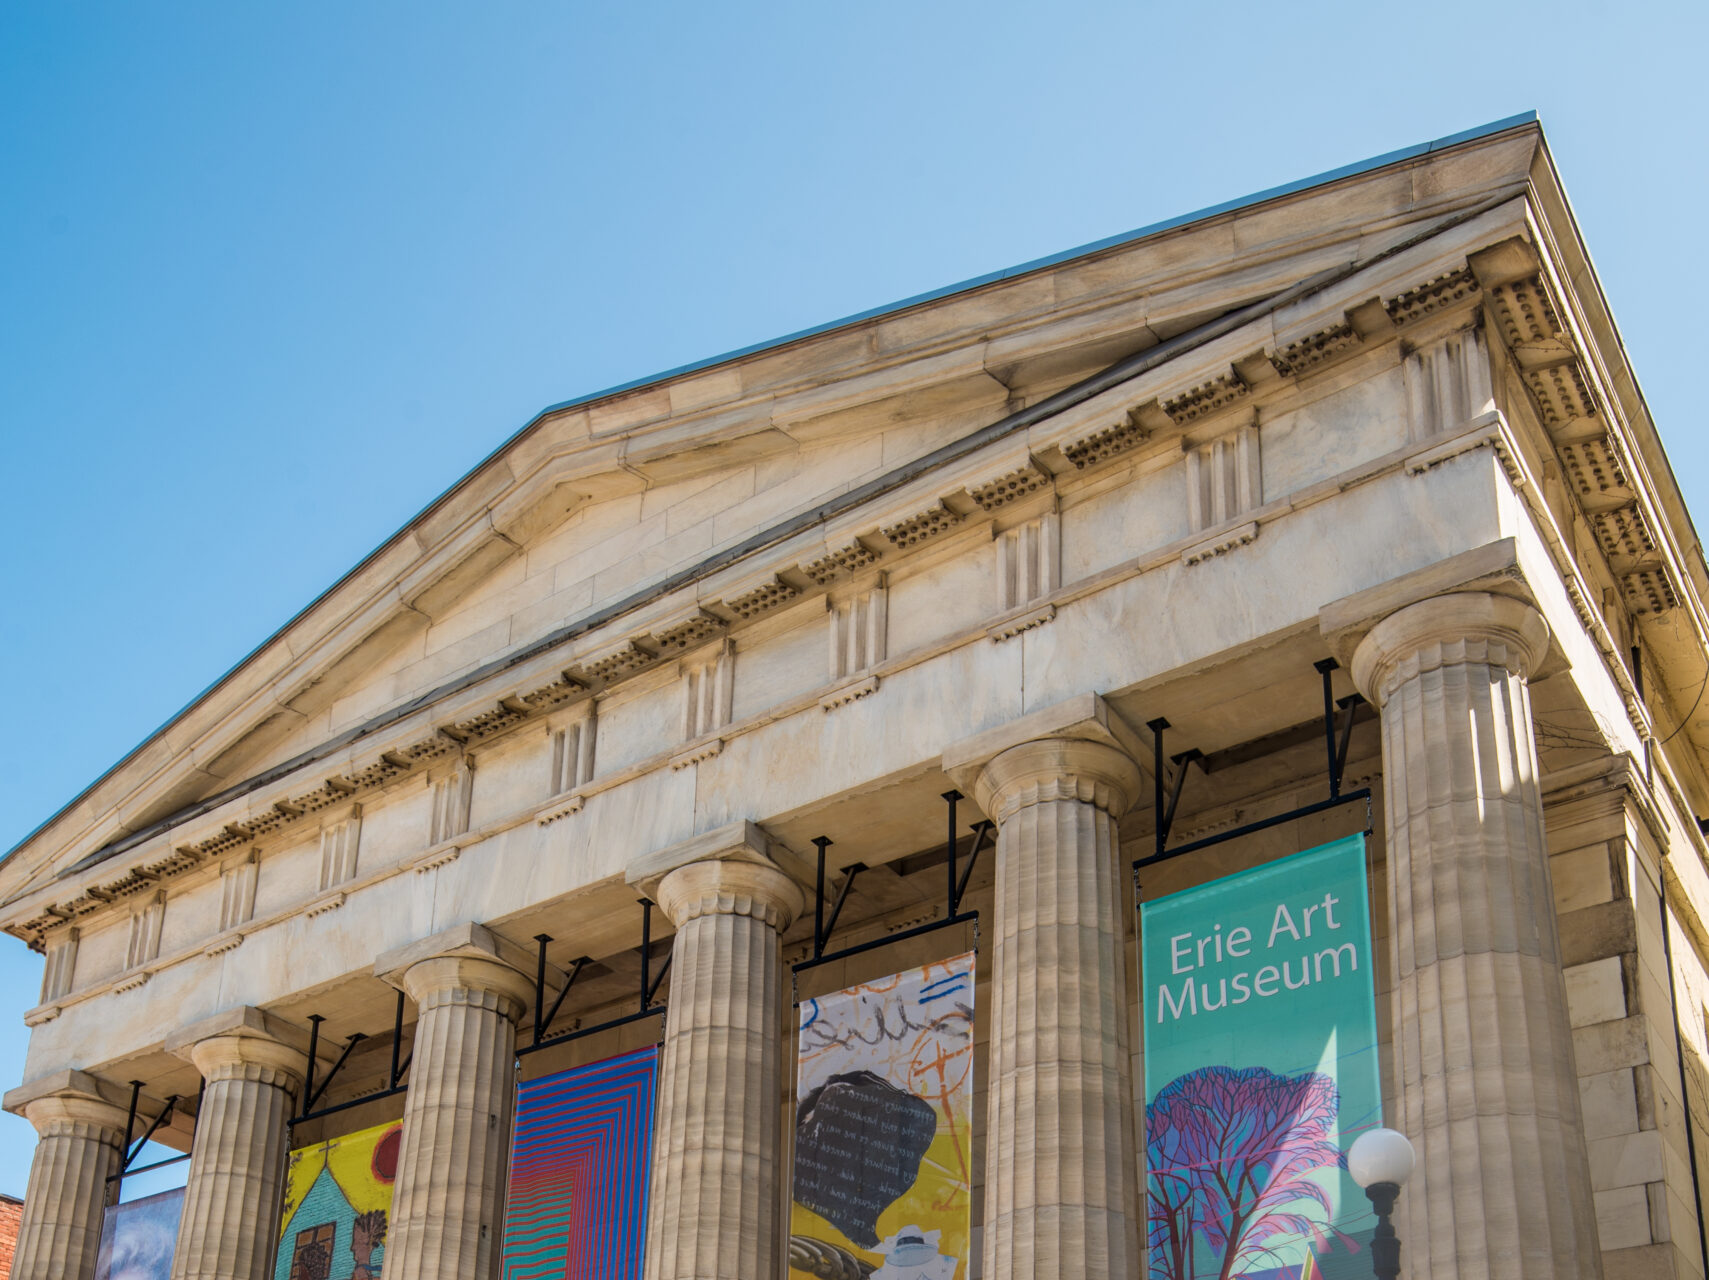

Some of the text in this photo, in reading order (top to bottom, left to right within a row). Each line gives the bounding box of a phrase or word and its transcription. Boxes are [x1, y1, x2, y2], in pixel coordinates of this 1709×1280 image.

[1171, 893, 1341, 976] Erie Art
[1157, 942, 1358, 1024] Museum
